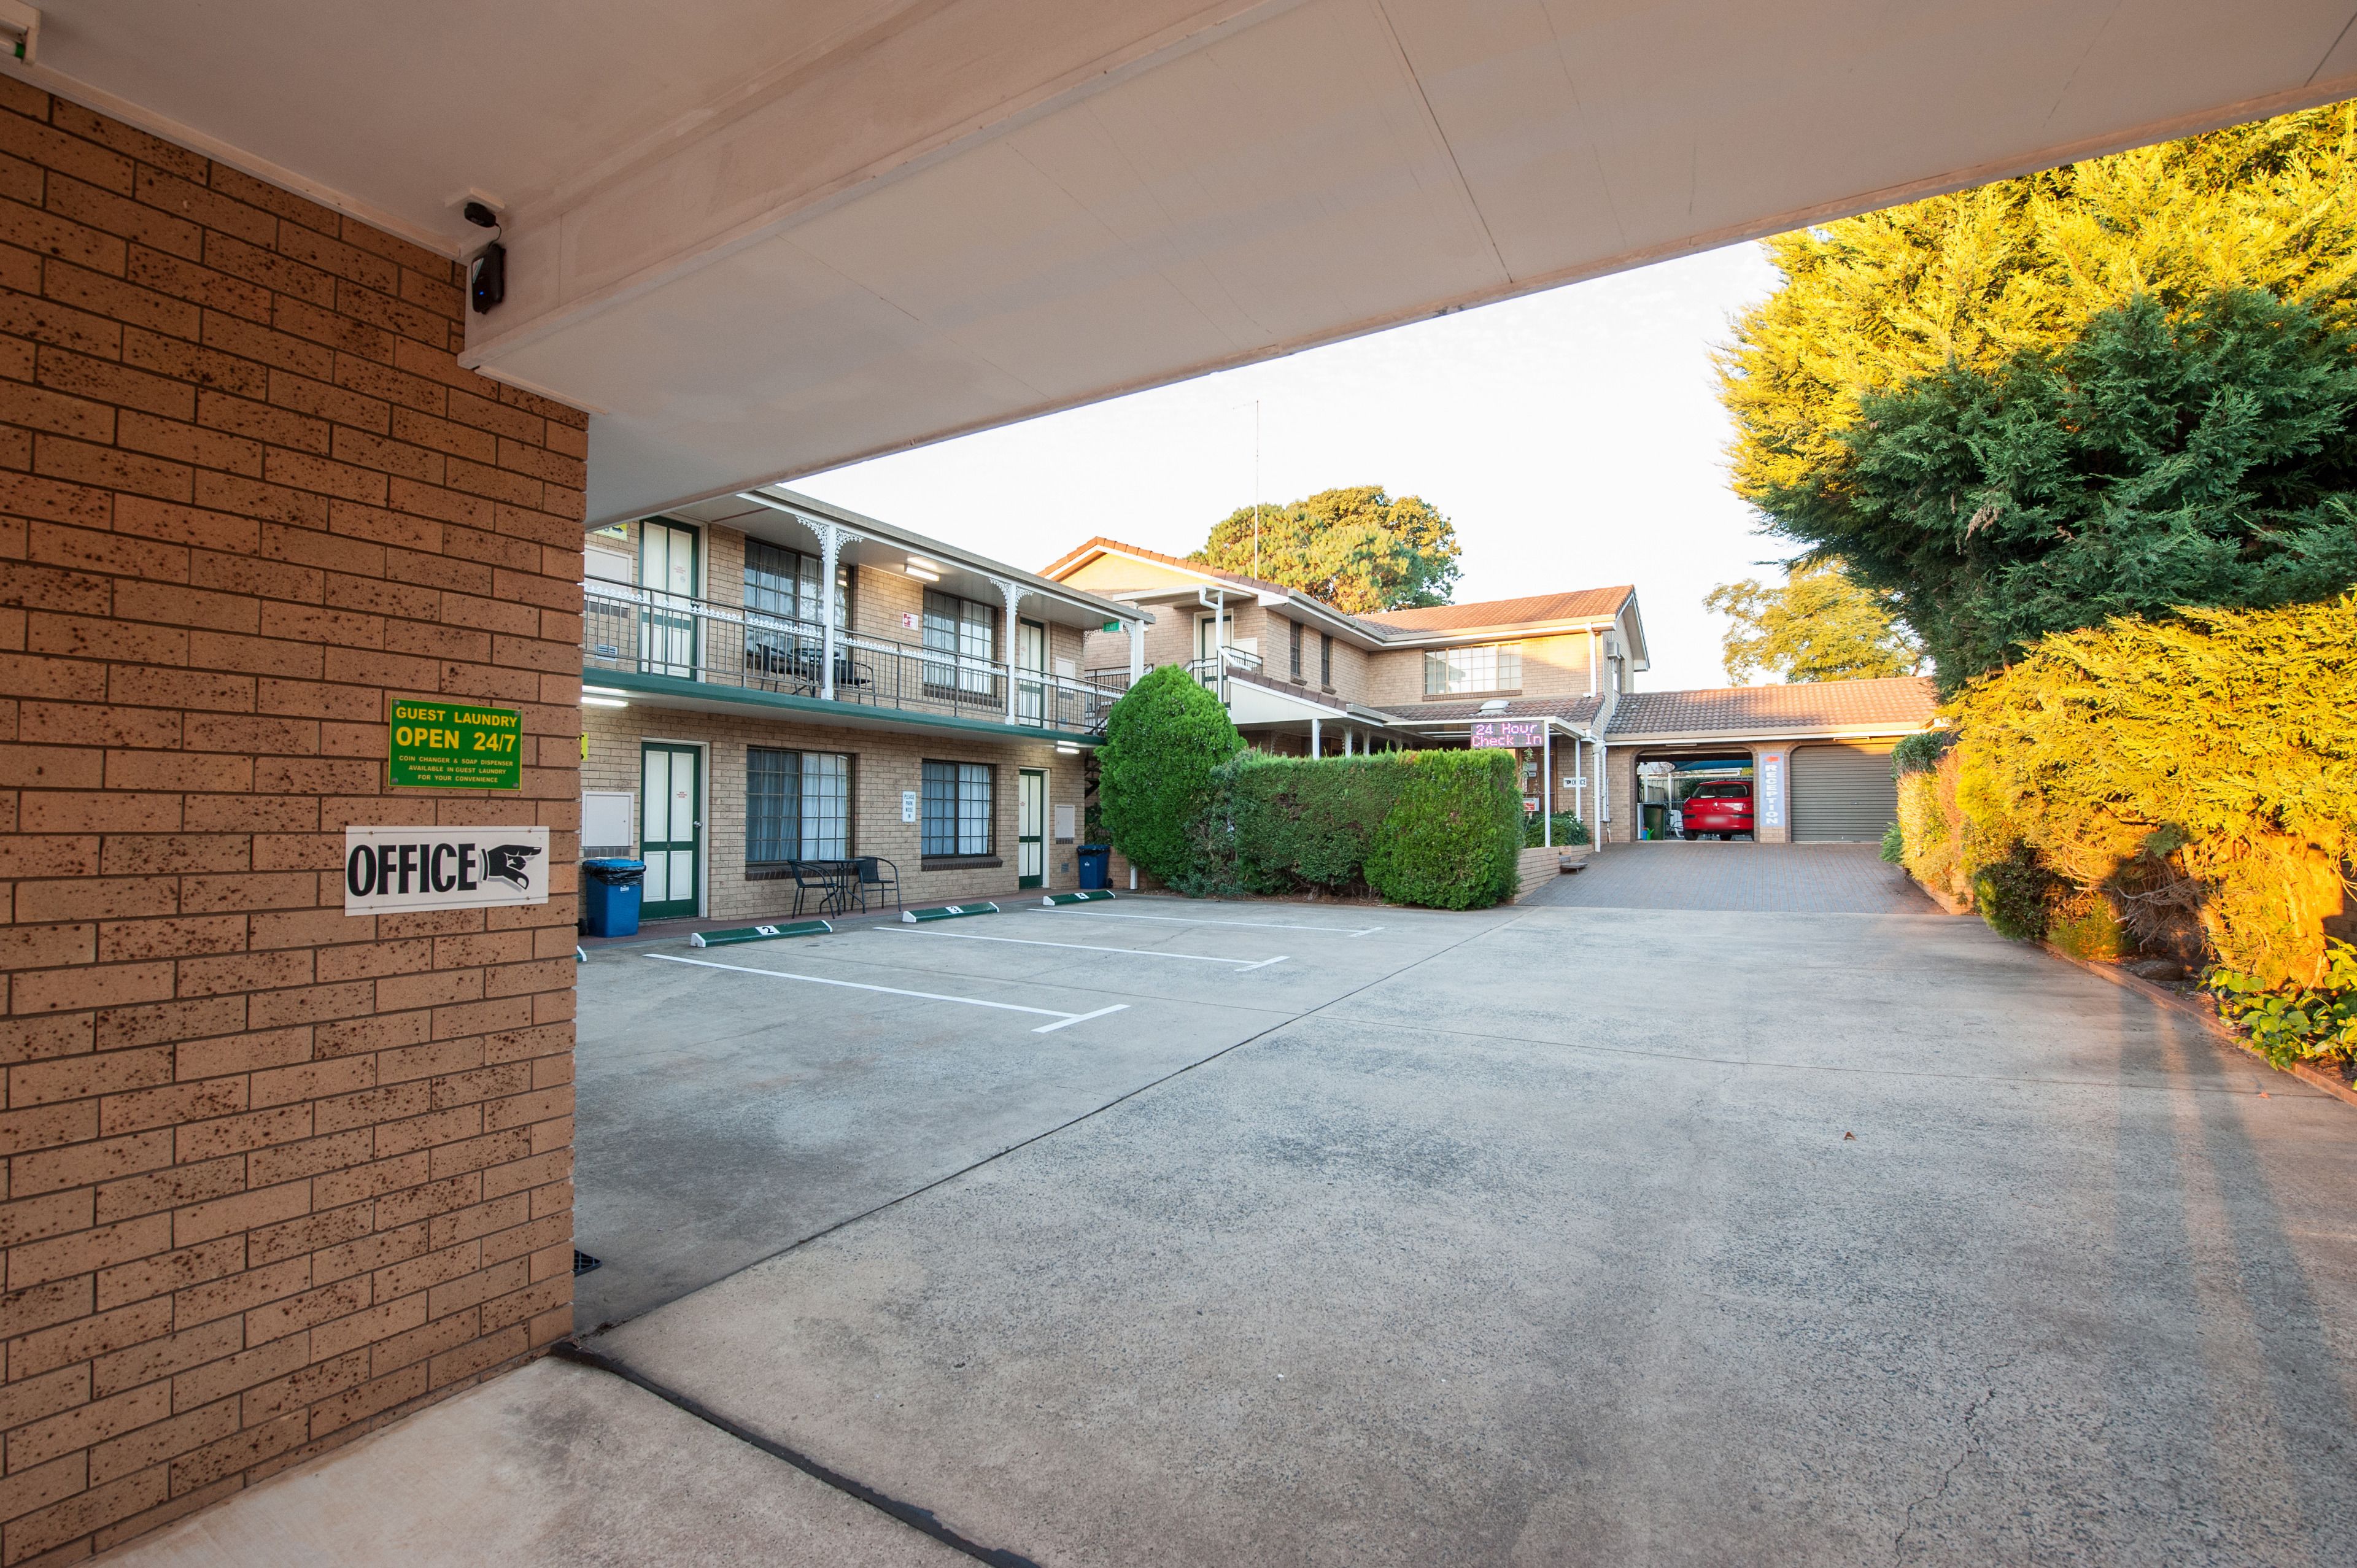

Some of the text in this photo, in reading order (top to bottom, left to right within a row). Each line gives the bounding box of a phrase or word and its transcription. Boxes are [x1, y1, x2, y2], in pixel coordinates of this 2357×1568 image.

[396, 707, 518, 728] GUEST LAUNDRY
[1476, 722, 1538, 735] 24 Hour
[396, 727, 516, 752] OPEN 24/7
[1472, 733, 1542, 746] Check In
[1765, 765, 1778, 824] RECEPTION
[347, 843, 477, 897] OFFICE
